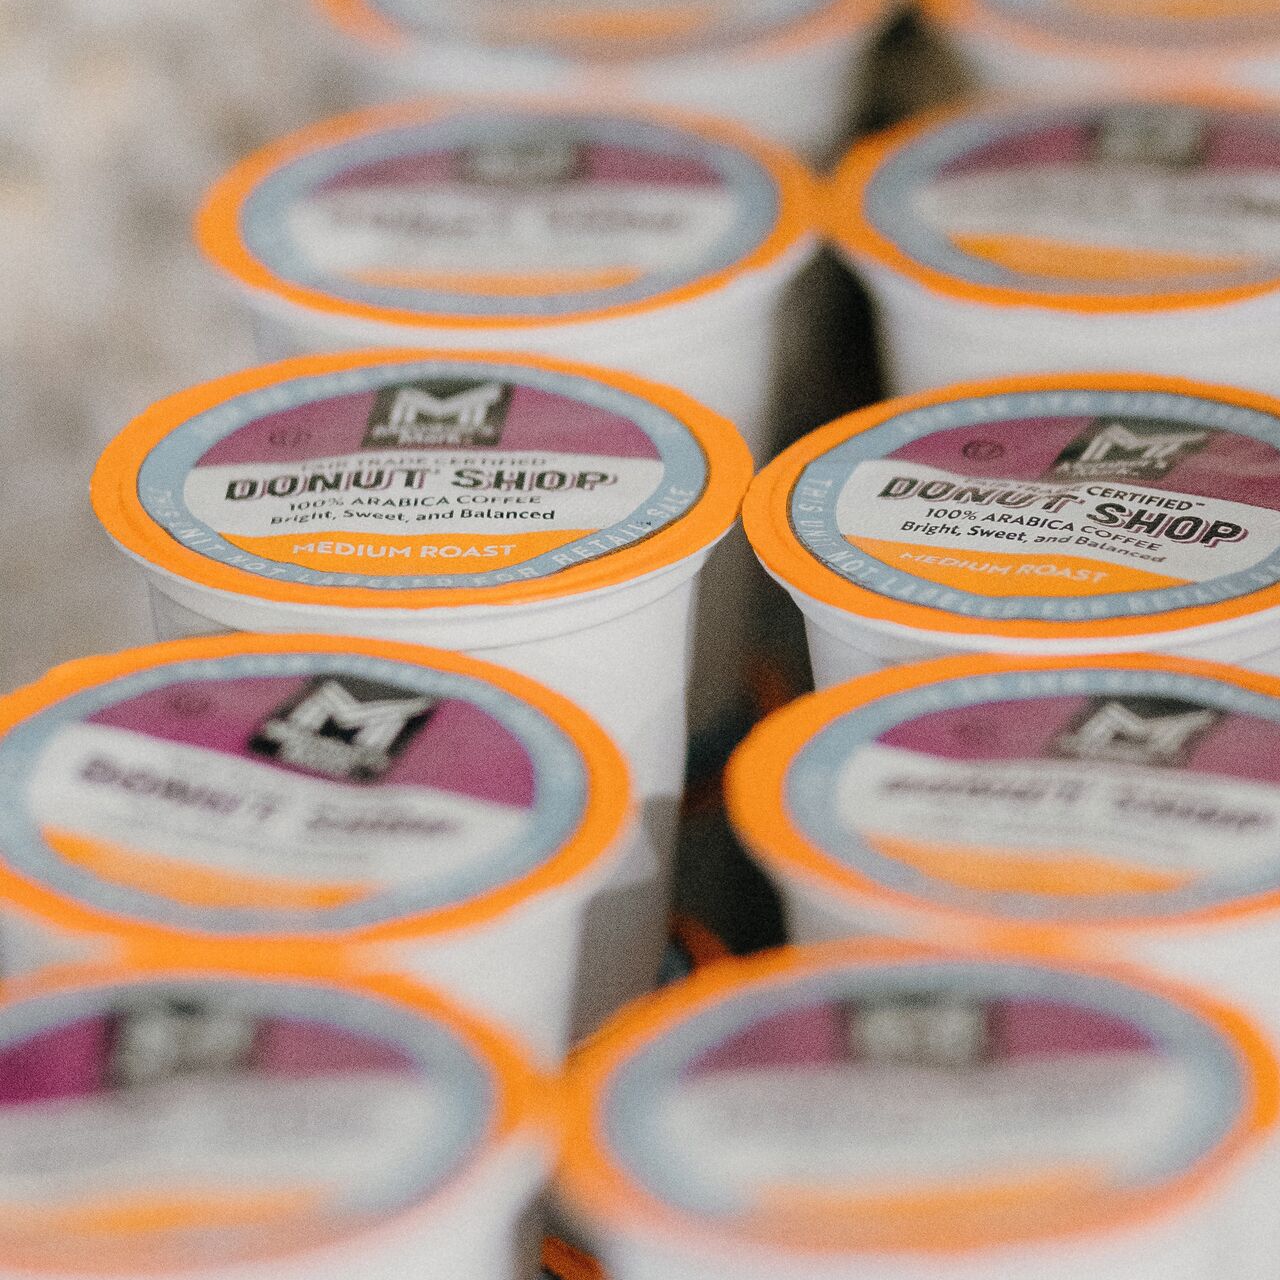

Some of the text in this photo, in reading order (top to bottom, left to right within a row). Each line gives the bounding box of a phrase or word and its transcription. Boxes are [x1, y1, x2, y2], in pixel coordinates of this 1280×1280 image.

[225, 468, 618, 500] DONUT SHOP
[271, 509, 555, 525] Bright, Sweet, and Balanced
[290, 495, 541, 511] 100% ARABICA COFFEE
[877, 476, 1249, 548] DONUT SHOP
[224, 555, 287, 576] NOT
[551, 523, 652, 566] RETAIL
[646, 486, 695, 519] SALE
[900, 521, 1166, 563] Bright, Sweet, and Balanced
[925, 508, 1163, 552] 100% ARABICA COFFEE
[292, 541, 516, 559] MEDIUM ROAST
[826, 550, 880, 579] NOT
[900, 552, 1109, 584] MEDIUM ROAST
